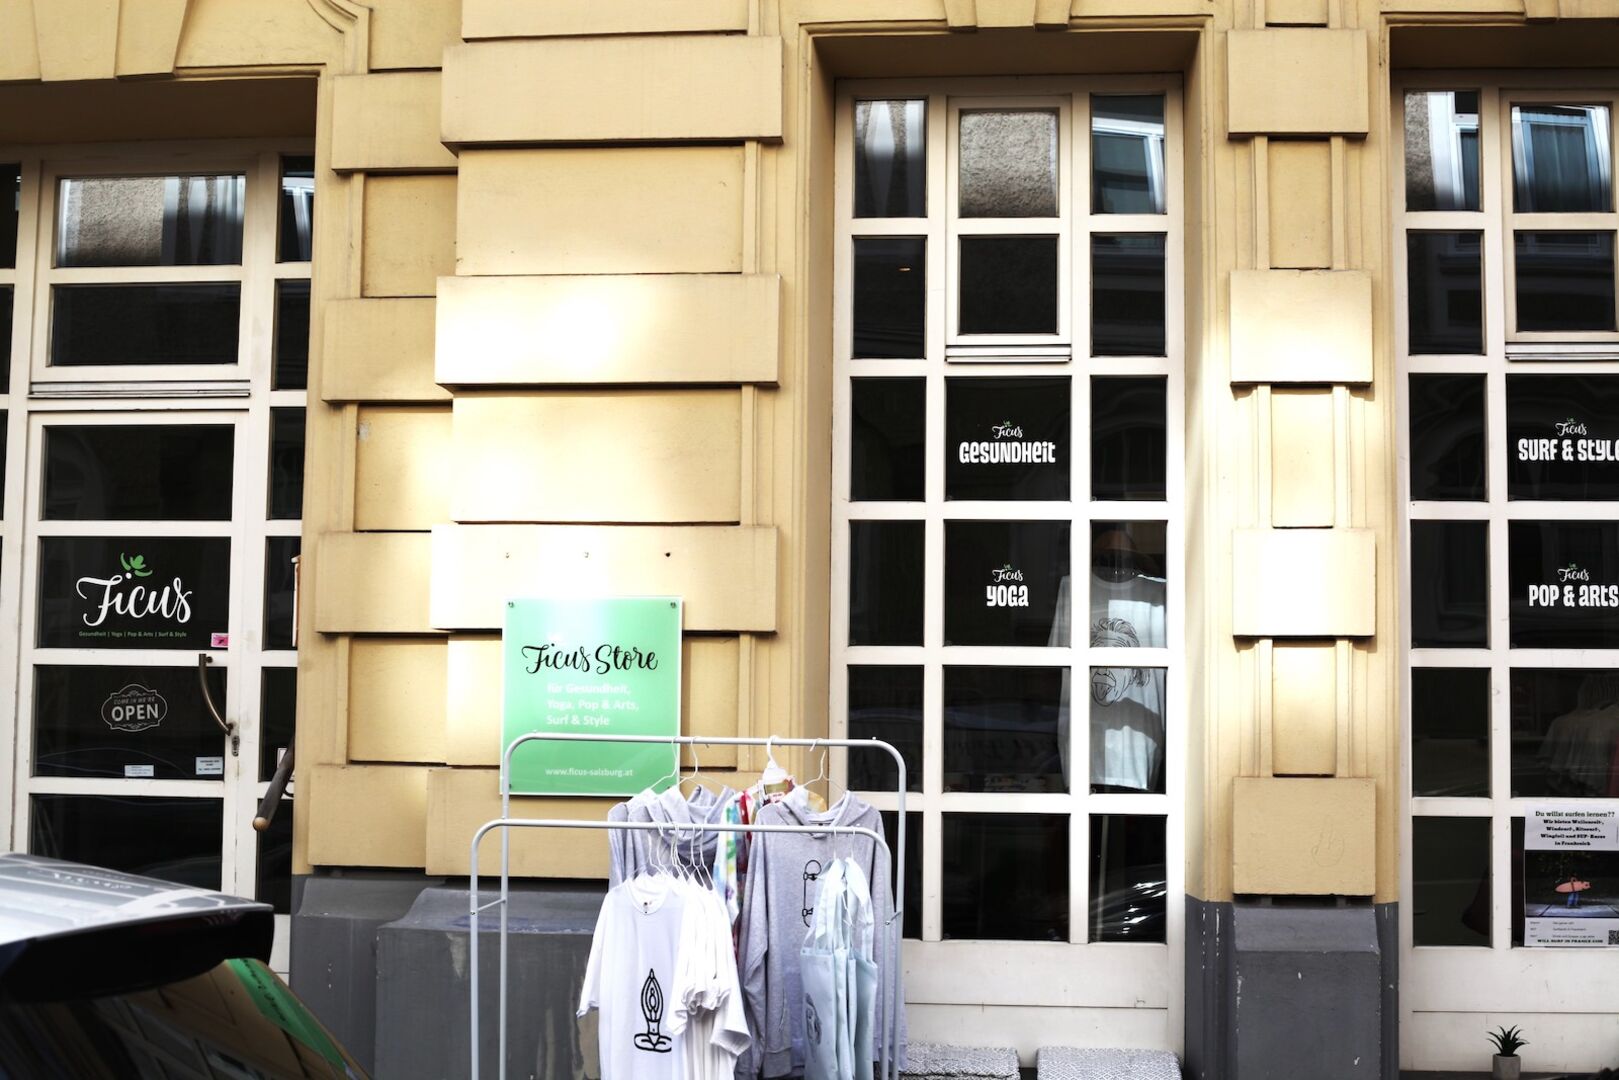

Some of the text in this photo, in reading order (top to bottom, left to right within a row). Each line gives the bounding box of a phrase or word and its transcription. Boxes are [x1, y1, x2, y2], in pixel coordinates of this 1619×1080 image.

[992, 425, 1023, 439] Ficus
[1555, 422, 1587, 436] Ficus
[1518, 438, 1559, 461] SURF
[1561, 438, 1574, 461] &
[992, 569, 1024, 583] Ficus
[1557, 568, 1590, 582] Ficus
[76, 572, 193, 627] Ficus
[1528, 584, 1560, 607] POP
[1563, 585, 1575, 607] &
[521, 643, 658, 674] Ficus Store
[111, 703, 159, 722] OPEN
[578, 700, 599, 711] Pop
[601, 700, 609, 709] &
[546, 714, 610, 727] Surf & Style
[544, 767, 634, 778] www.ficus-salzburg.at
